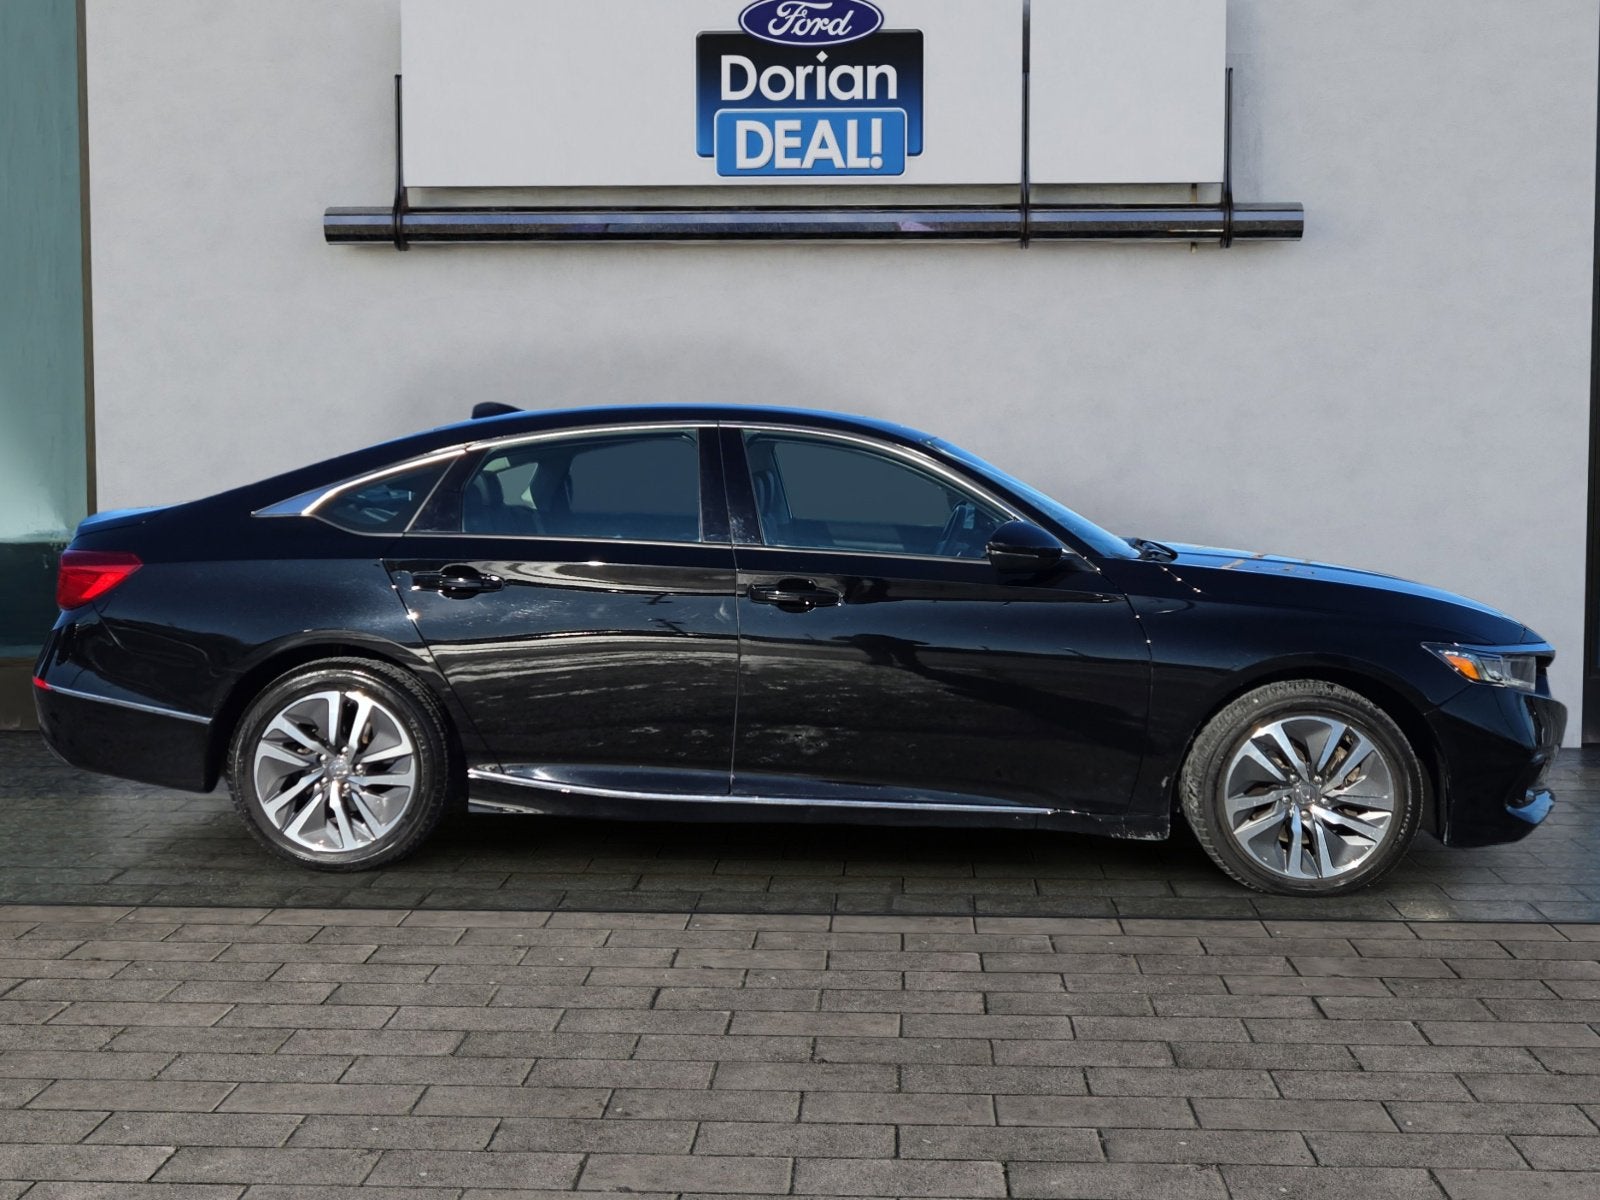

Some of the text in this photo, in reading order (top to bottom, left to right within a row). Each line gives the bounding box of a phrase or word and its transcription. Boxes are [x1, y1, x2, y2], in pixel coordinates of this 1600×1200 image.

[768, 1, 855, 36] Ford
[720, 50, 898, 101] Dorian
[735, 117, 883, 169] DEAL!
